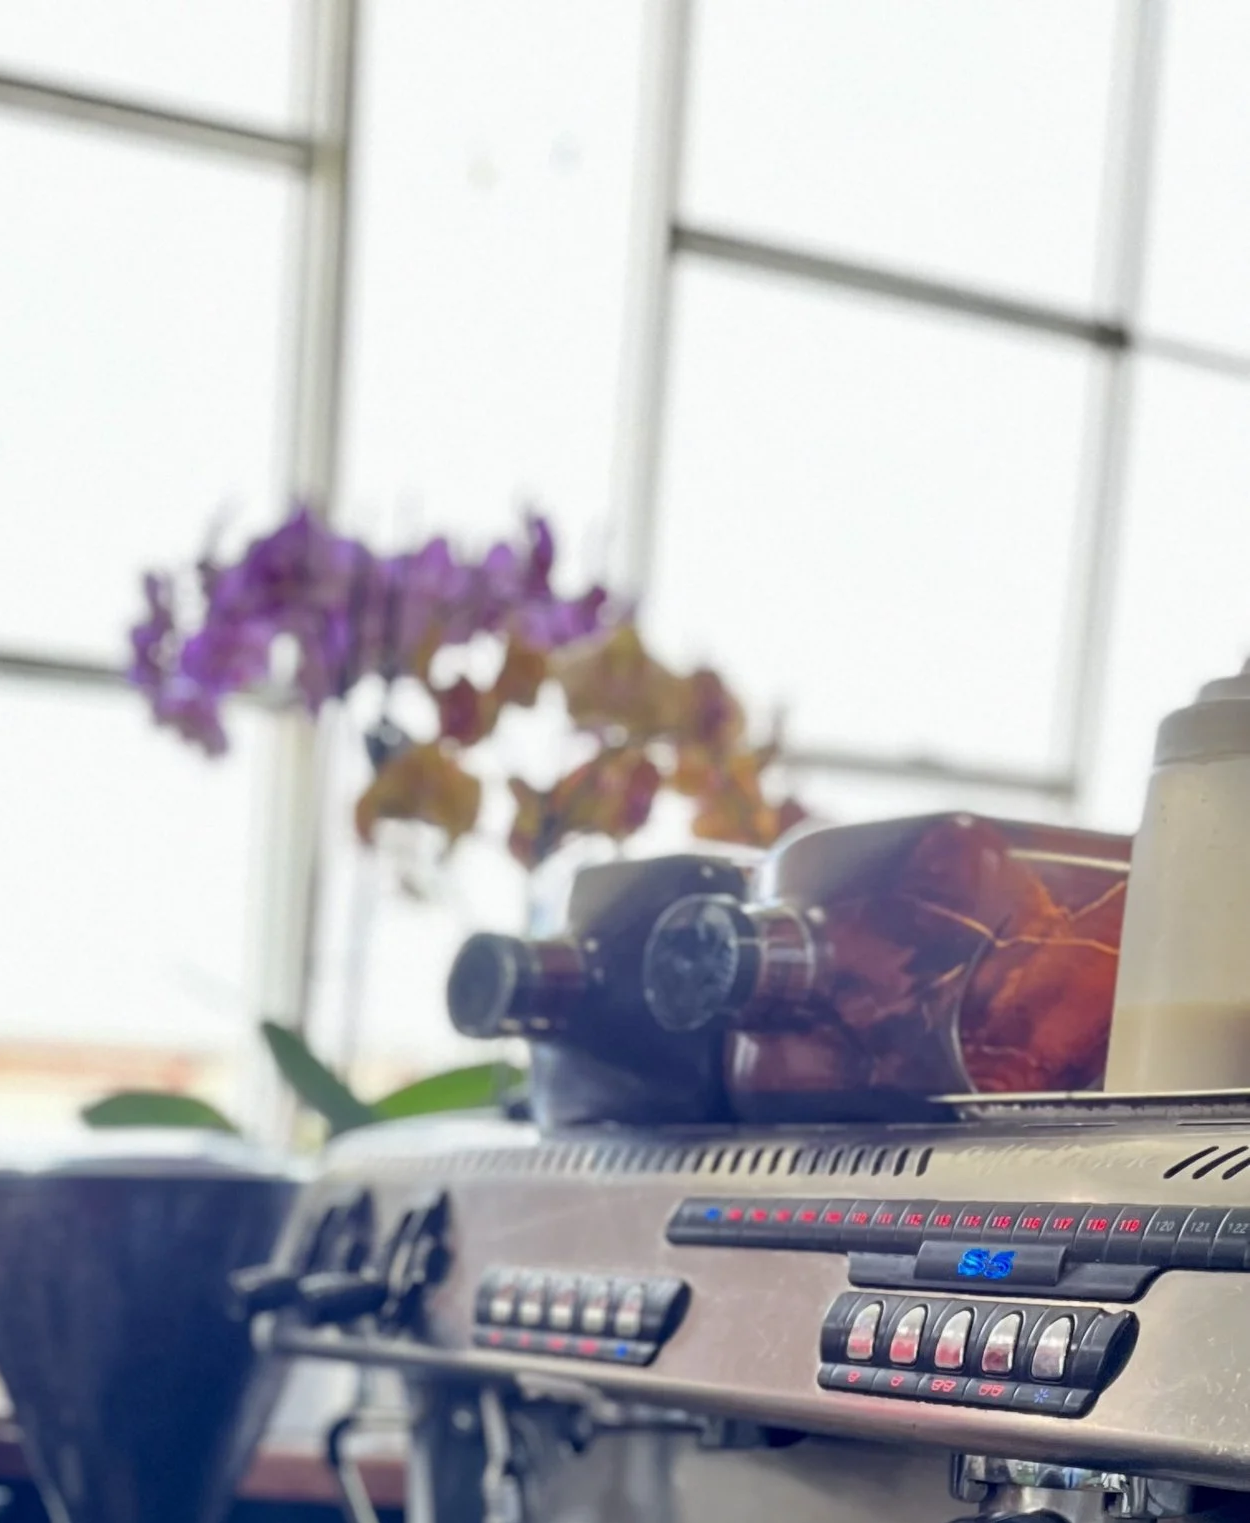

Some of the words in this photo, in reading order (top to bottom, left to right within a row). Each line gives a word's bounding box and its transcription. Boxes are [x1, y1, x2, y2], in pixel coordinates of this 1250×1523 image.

[933, 1214, 951, 1227] 113
[962, 1215, 981, 1227] 114
[992, 1215, 1012, 1228] 115
[1021, 1216, 1041, 1230] 116
[1053, 1217, 1074, 1230] 117
[1086, 1218, 1107, 1231] 118
[1119, 1219, 1141, 1232] 119
[1155, 1220, 1175, 1232] 120
[1190, 1221, 1210, 1233] 121
[1227, 1222, 1250, 1234] 122
